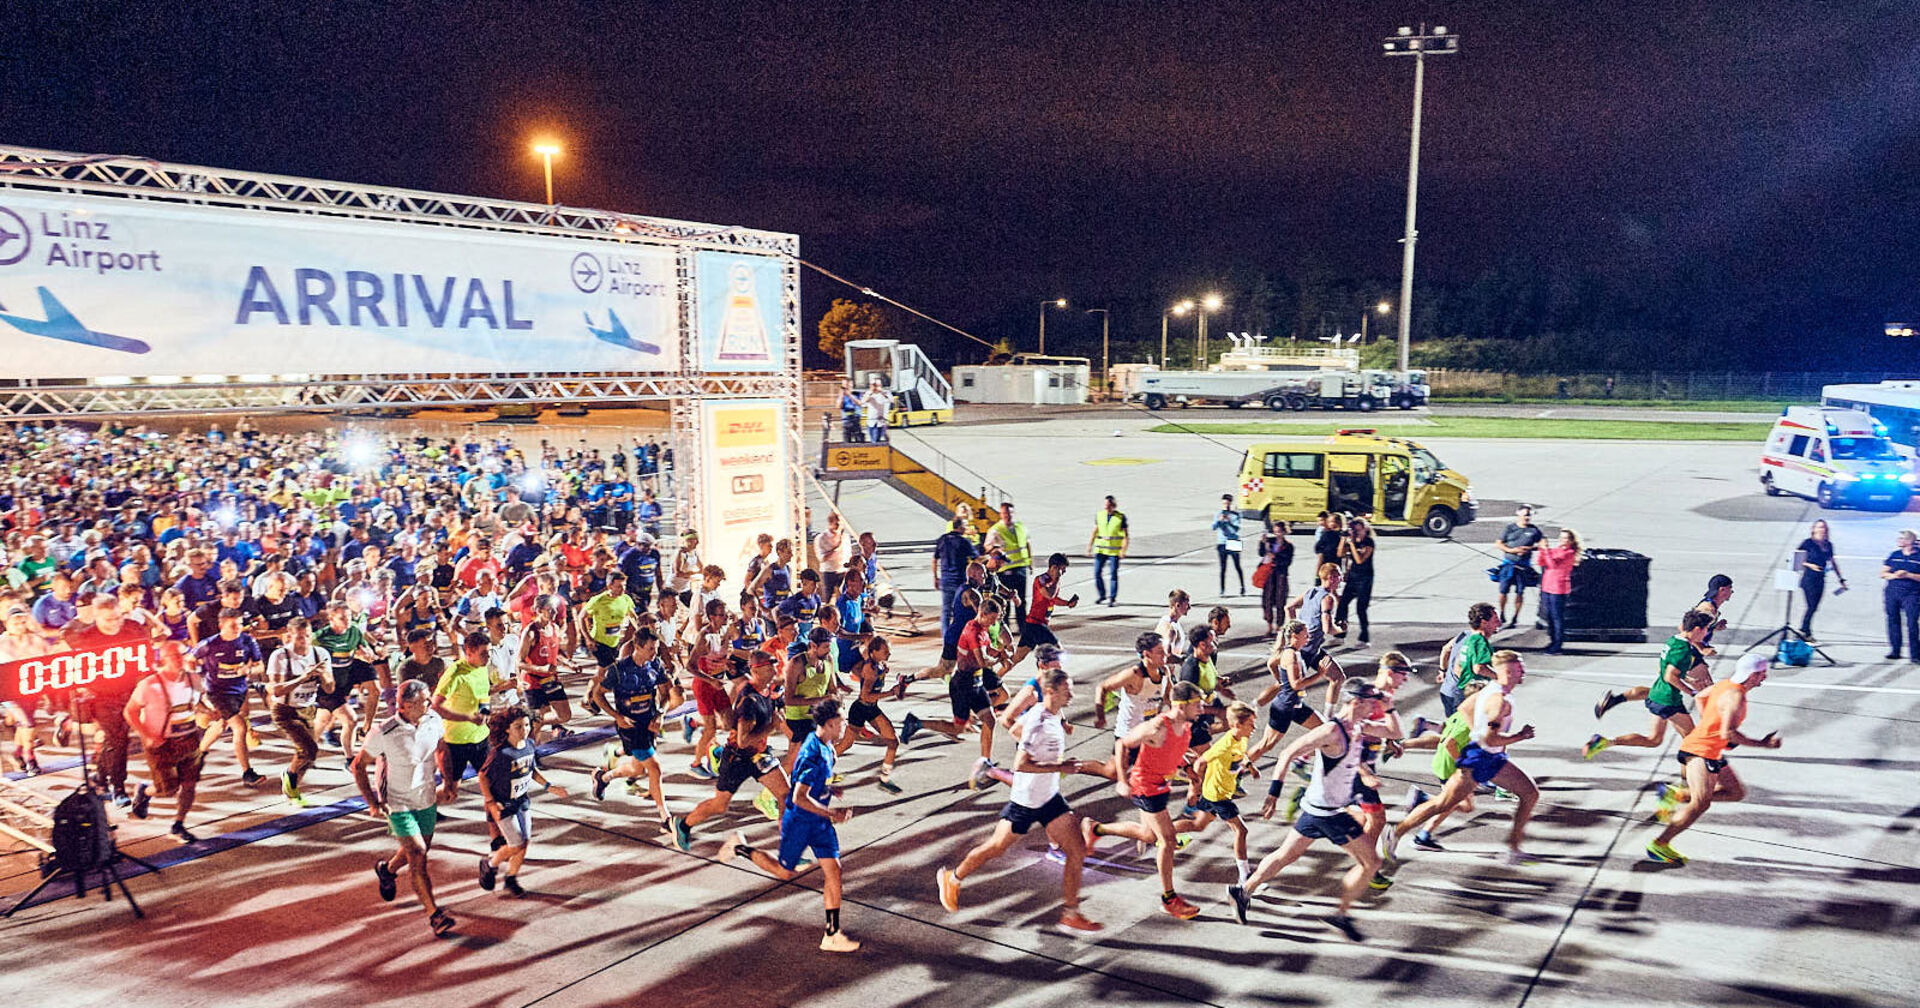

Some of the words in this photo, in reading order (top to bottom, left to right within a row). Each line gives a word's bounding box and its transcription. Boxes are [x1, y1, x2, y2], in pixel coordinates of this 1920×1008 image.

[40, 212, 110, 240] Linz
[46, 243, 162, 274] Airport
[608, 256, 641, 275] Linz
[234, 265, 533, 330] ARRIVAL
[609, 278, 666, 299] Airport
